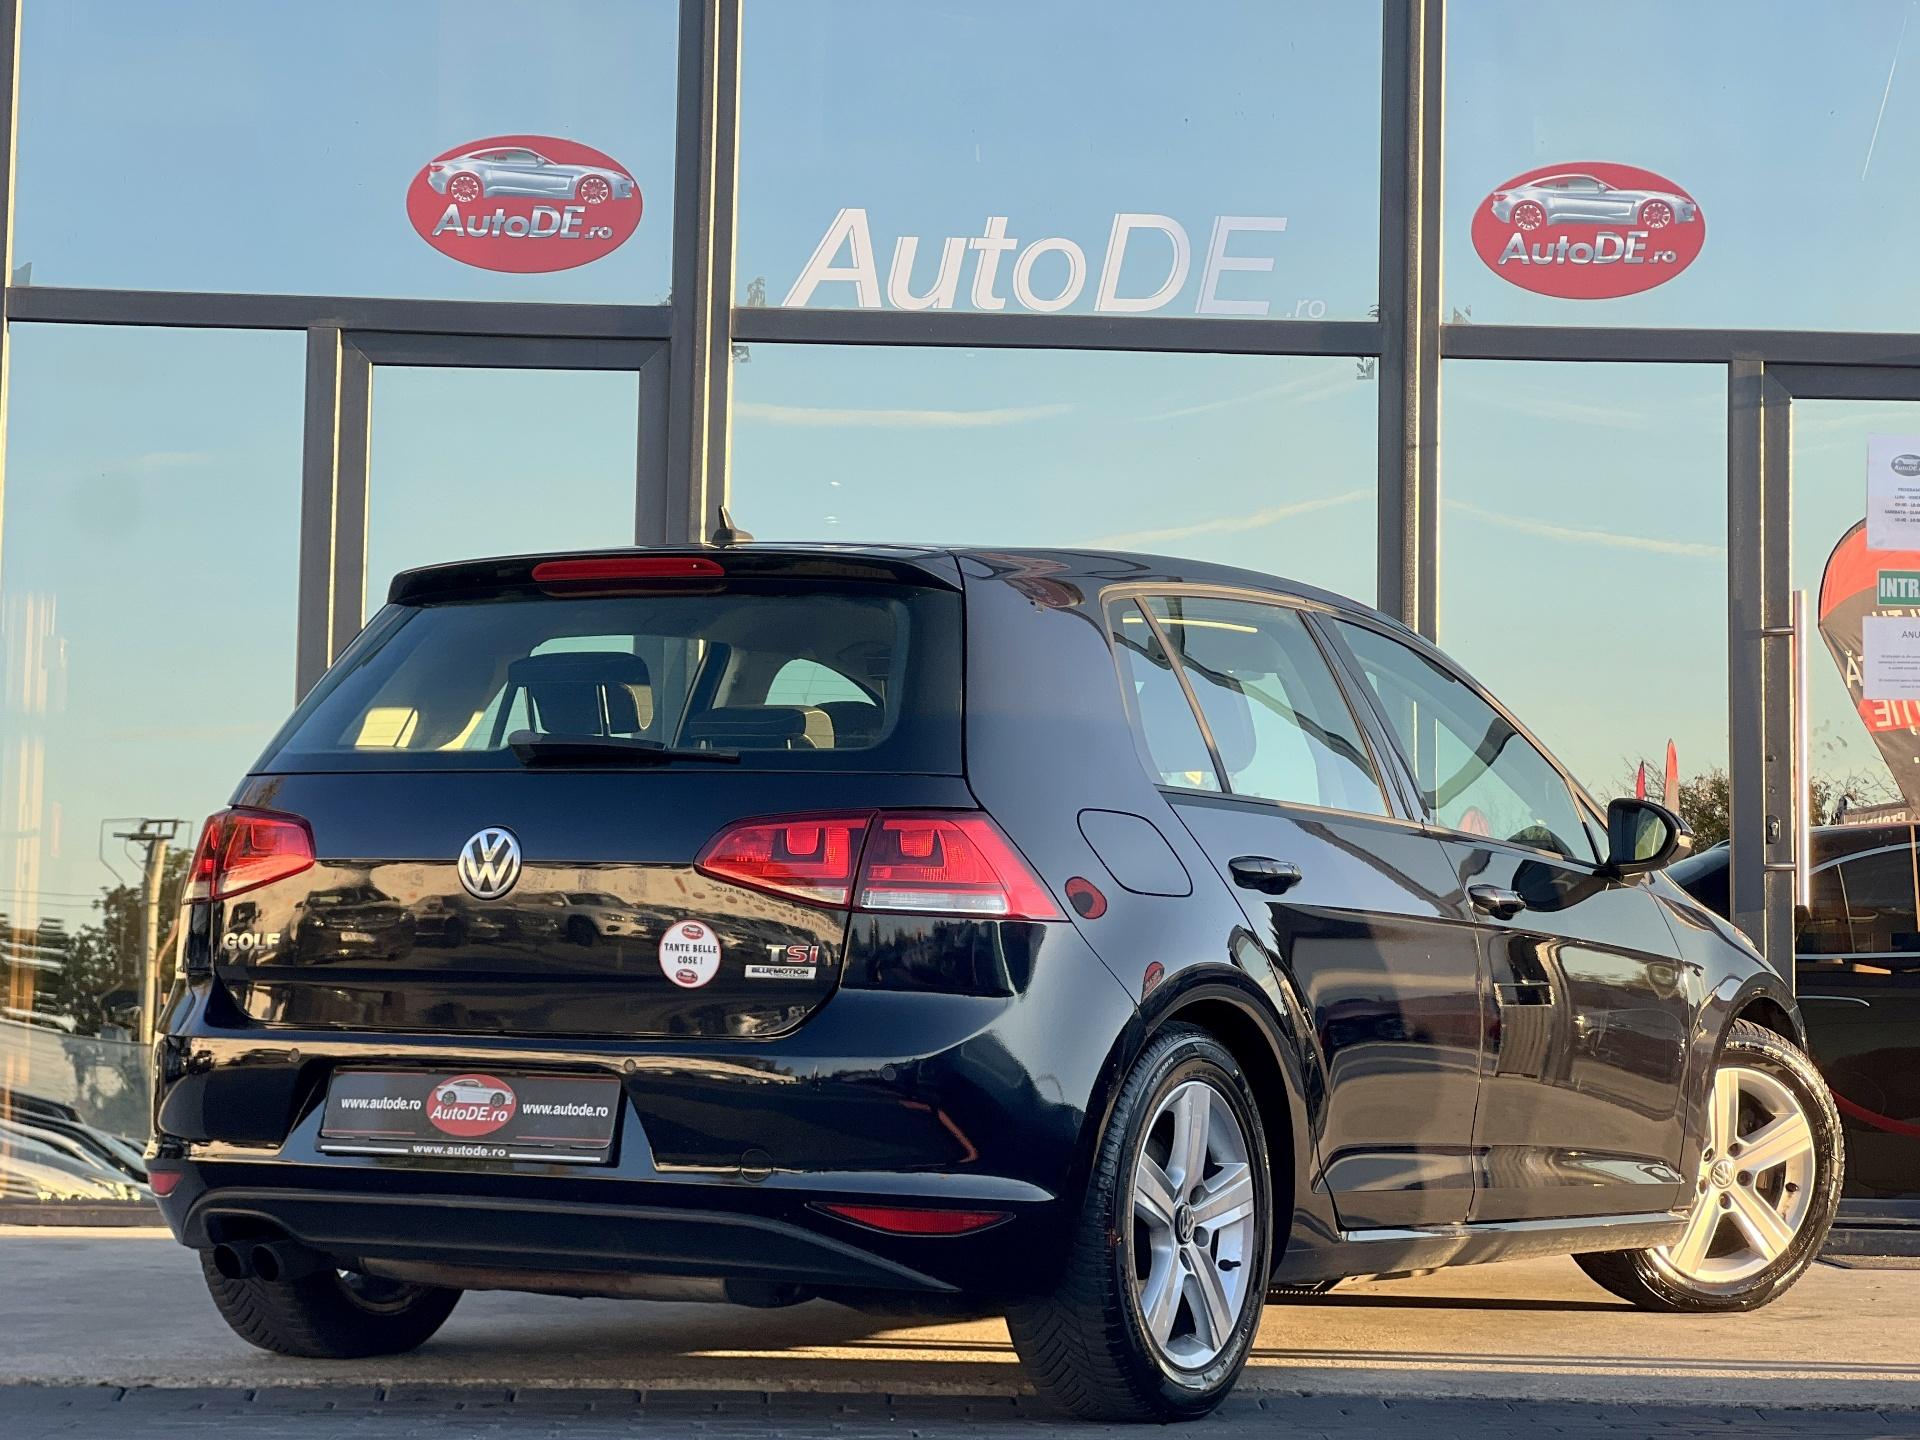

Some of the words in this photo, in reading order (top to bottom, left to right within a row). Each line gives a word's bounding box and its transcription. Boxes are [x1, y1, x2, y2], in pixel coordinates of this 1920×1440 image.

[1880, 577, 1920, 598] INTR
[222, 932, 281, 951] GOLF
[664, 942, 690, 952] TANTE
[693, 944, 718, 953] BELLE
[677, 955, 698, 965] COSE
[765, 944, 820, 963] TSI
[340, 1096, 421, 1111] www.autode.ro
[522, 1102, 609, 1117] www.autode.ro
[430, 1105, 508, 1122] AutoDE.ro
[412, 1145, 506, 1157] www.autode.ro
